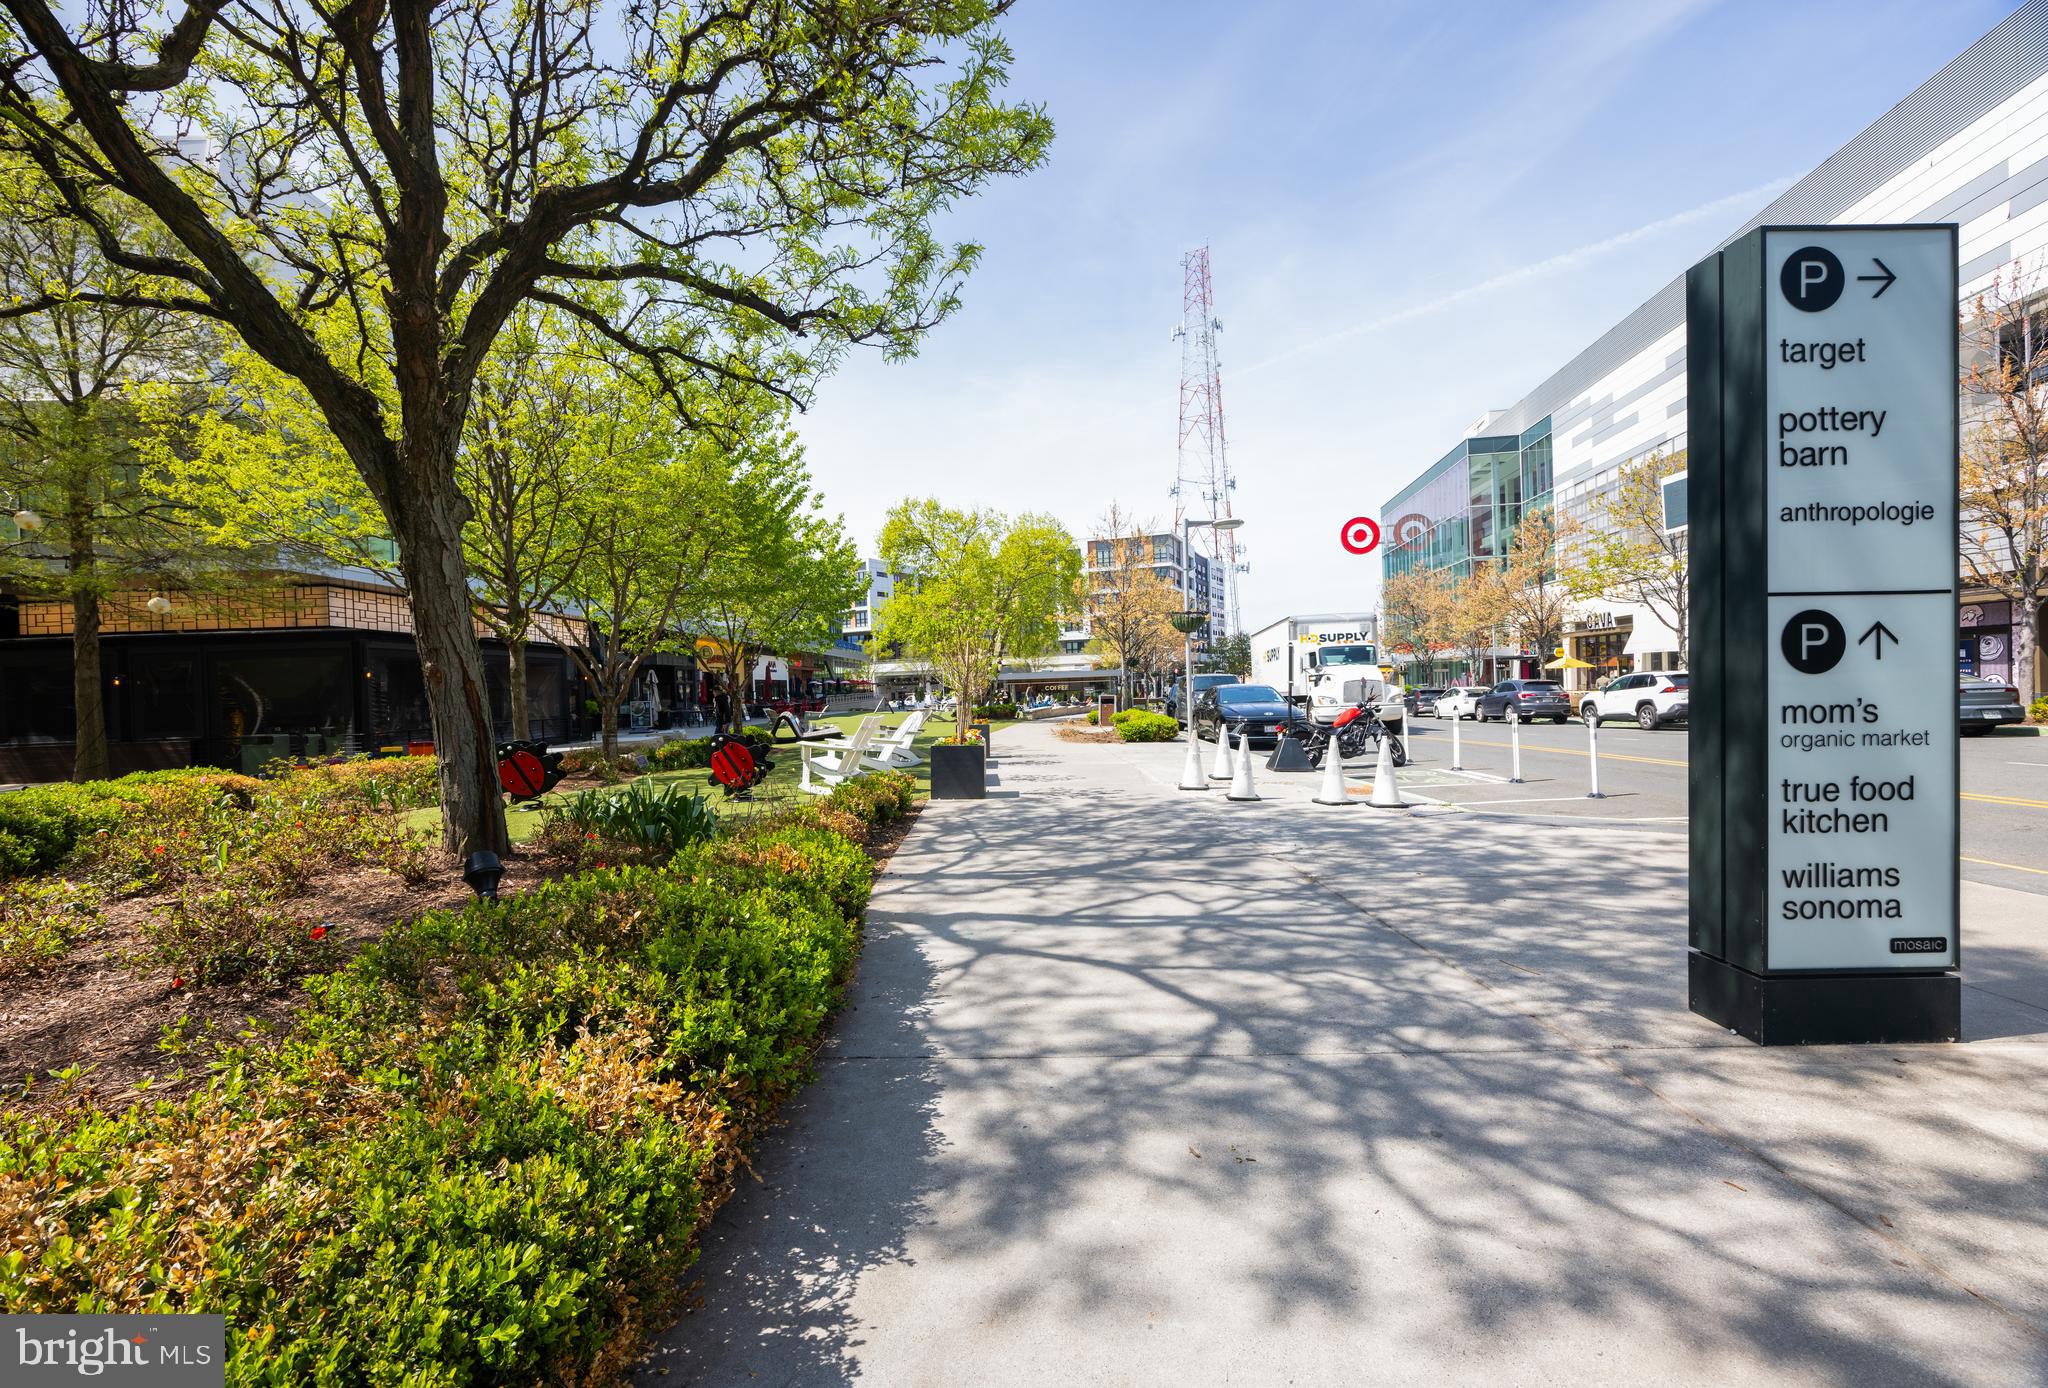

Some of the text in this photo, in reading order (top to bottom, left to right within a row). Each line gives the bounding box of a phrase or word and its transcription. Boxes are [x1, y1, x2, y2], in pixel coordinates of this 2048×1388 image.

[1800, 260, 1828, 299] P
[1780, 338, 1866, 370] target
[1779, 407, 1887, 438] pottery
[1779, 440, 1848, 467] barn
[1780, 501, 1935, 526] anthropologie
[1587, 611, 1615, 628] CAVA
[1319, 632, 1368, 643] SUPPLY
[1801, 623, 1829, 661] P
[1781, 698, 1879, 724] mom's
[1781, 729, 1930, 752] organic market
[1781, 775, 1915, 802] true food
[1782, 808, 1889, 833] kitchen
[1782, 863, 1900, 888] williams
[1782, 898, 1902, 920] sonoma
[1893, 940, 1943, 951] mosaic
